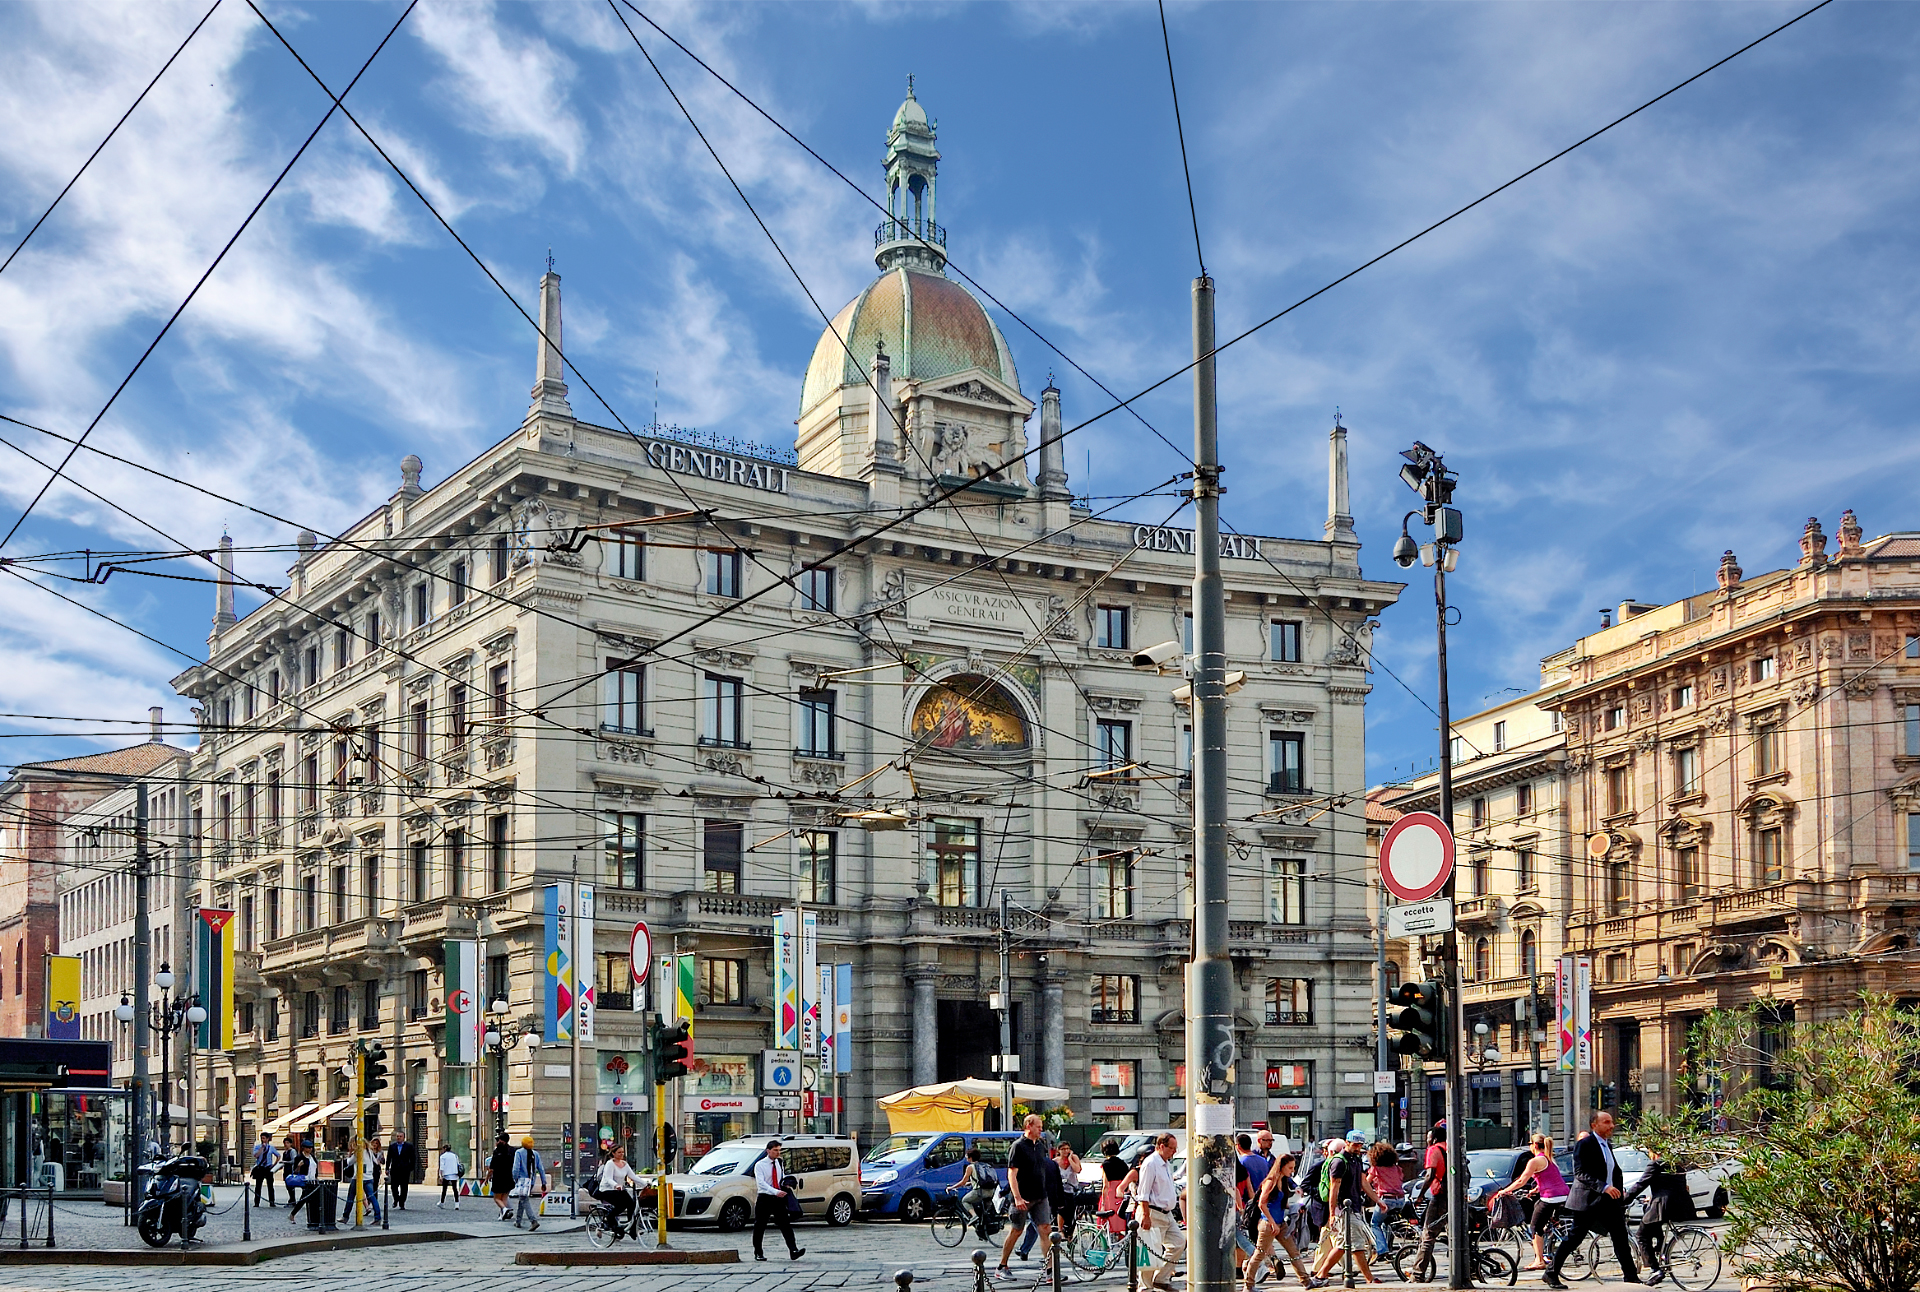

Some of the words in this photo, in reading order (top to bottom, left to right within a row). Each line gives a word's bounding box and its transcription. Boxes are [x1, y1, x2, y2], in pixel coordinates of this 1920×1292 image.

[647, 441, 790, 494] GENERALI
[1133, 525, 1262, 560] GENALI
[931, 590, 1021, 610] ASSICVRAZIONI
[947, 605, 1005, 621] GENERALI
[558, 904, 566, 941] EXPO
[1403, 906, 1435, 916] eccetto
[783, 931, 791, 964] EXPO
[580, 1002, 588, 1036] EXPO
[804, 1018, 812, 1048] EXPO
[712, 1062, 746, 1074] LIFE
